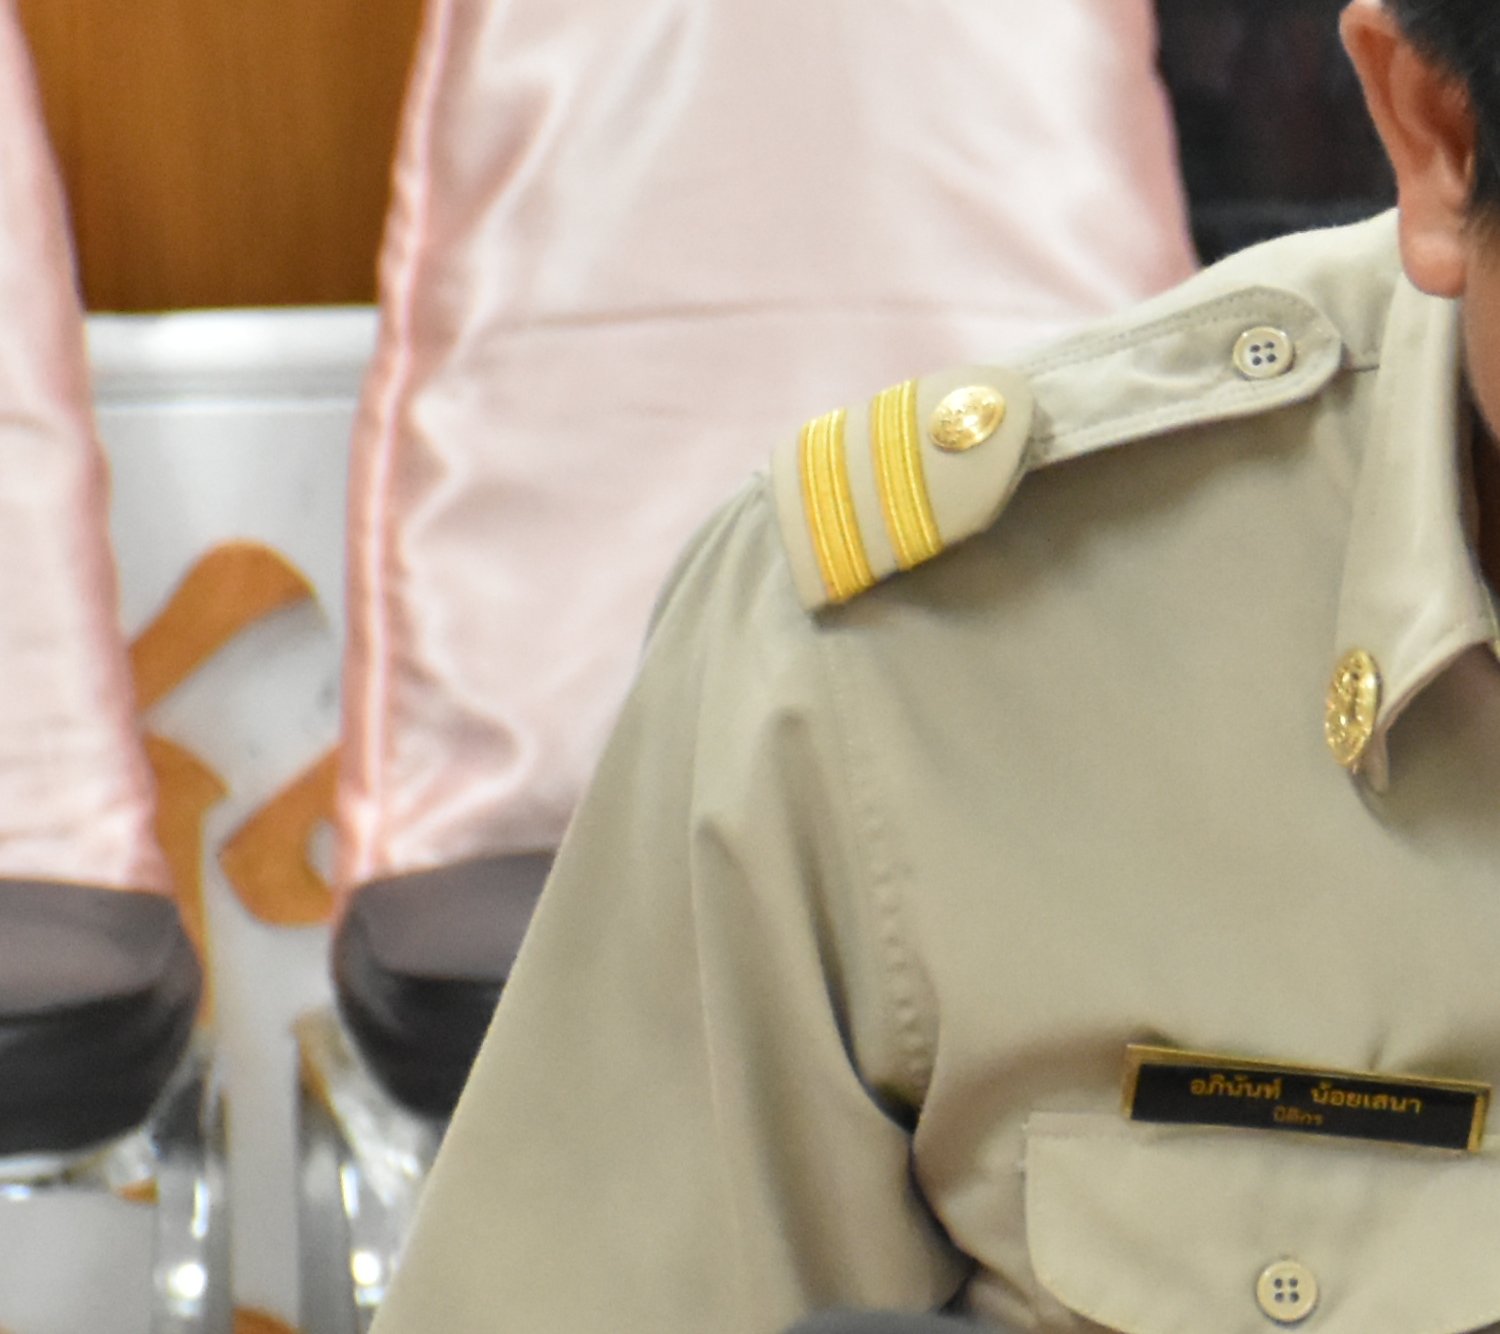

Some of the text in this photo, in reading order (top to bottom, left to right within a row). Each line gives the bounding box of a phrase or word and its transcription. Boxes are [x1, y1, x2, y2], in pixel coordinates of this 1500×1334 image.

[1189, 1073, 1423, 1115] อภินันท์ น้อยเสนา
